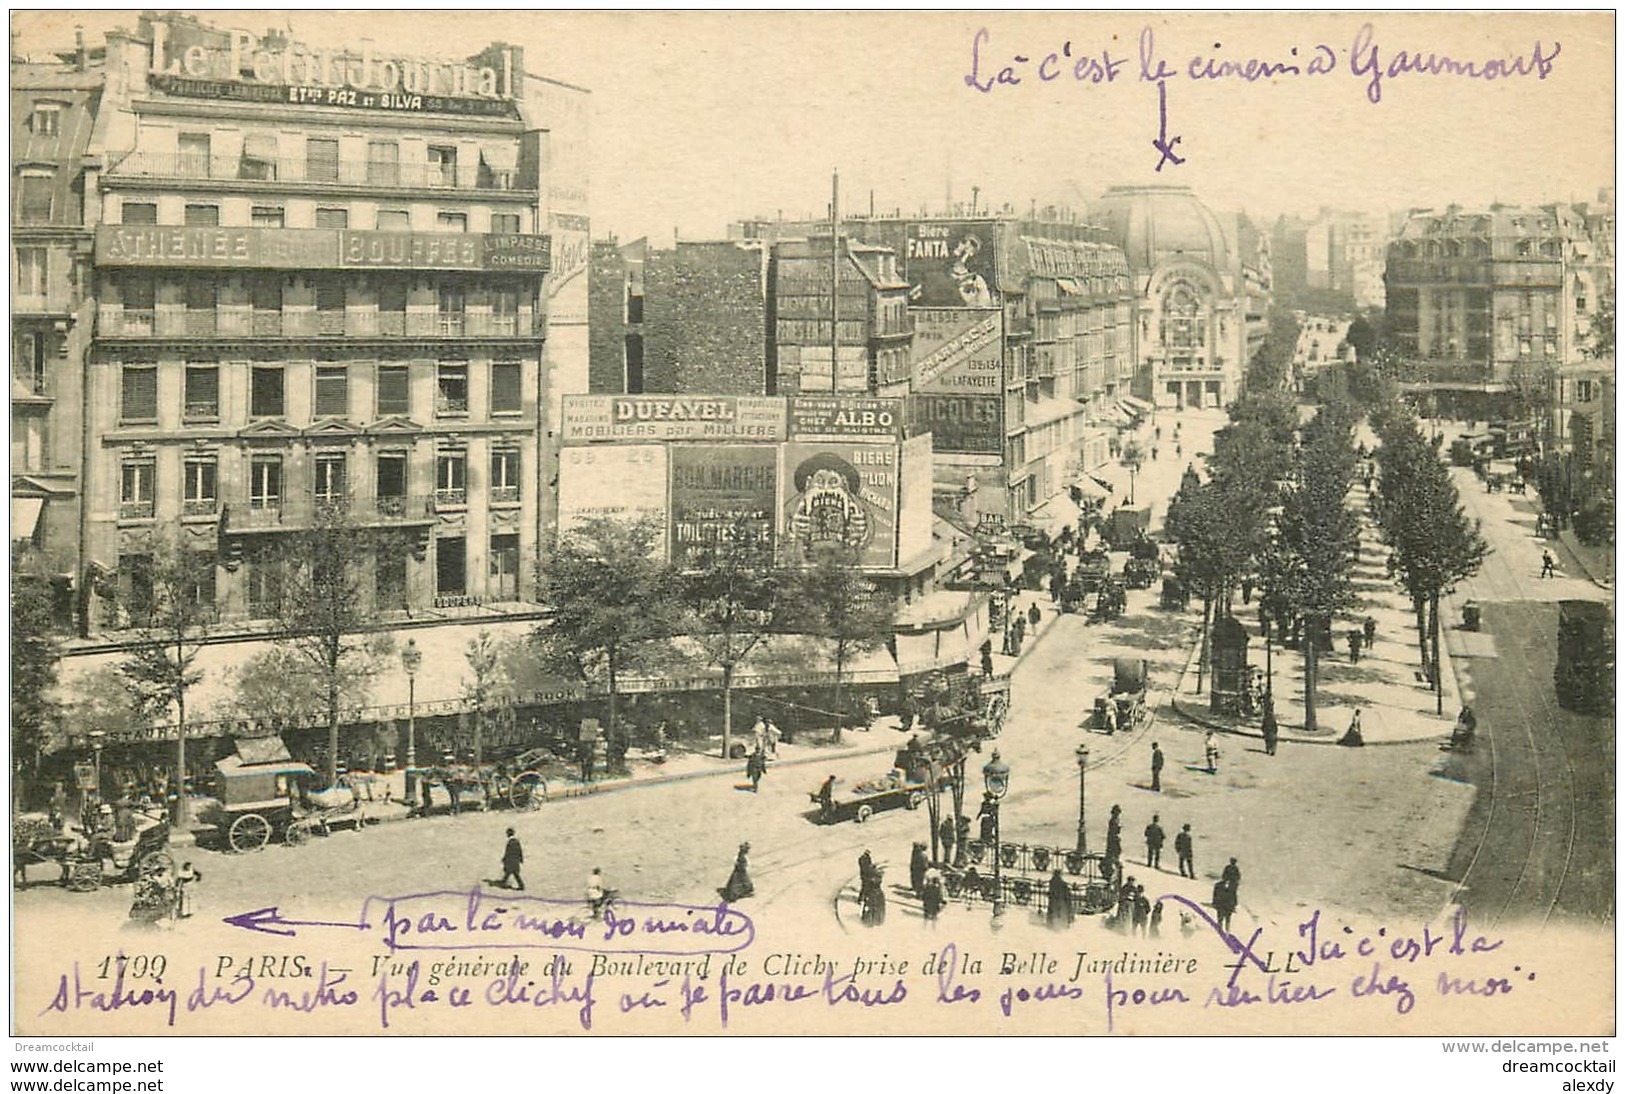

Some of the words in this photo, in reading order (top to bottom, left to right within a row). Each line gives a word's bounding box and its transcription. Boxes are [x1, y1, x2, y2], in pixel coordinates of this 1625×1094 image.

[150, 21, 207, 78] Le
[230, 29, 342, 86] Petit
[347, 40, 515, 99] Journal
[1039, 41, 1128, 83] c'est
[1140, 26, 1177, 82] le
[1351, 22, 1562, 104] Gaumont
[329, 91, 357, 105] PAZ
[381, 94, 422, 109] SILVA
[345, 236, 476, 263] BOUFFES
[908, 239, 949, 258] FANTA
[918, 319, 996, 377] PHARMACIE
[953, 376, 996, 387] LAFAYETTE
[616, 401, 735, 420] DUFAYEL
[834, 411, 893, 427] ALBO
[571, 425, 657, 437] MOBILIERS
[666, 427, 693, 438] par
[704, 425, 776, 436] MILLIERS
[853, 452, 893, 466] BIERE
[384, 900, 457, 954] par
[1450, 903, 1503, 955] la
[372, 960, 472, 1028] place
[822, 965, 907, 1006] tous
[937, 942, 981, 1003] les
[1105, 966, 1189, 1032] pour
[1352, 961, 1415, 1014] chez
